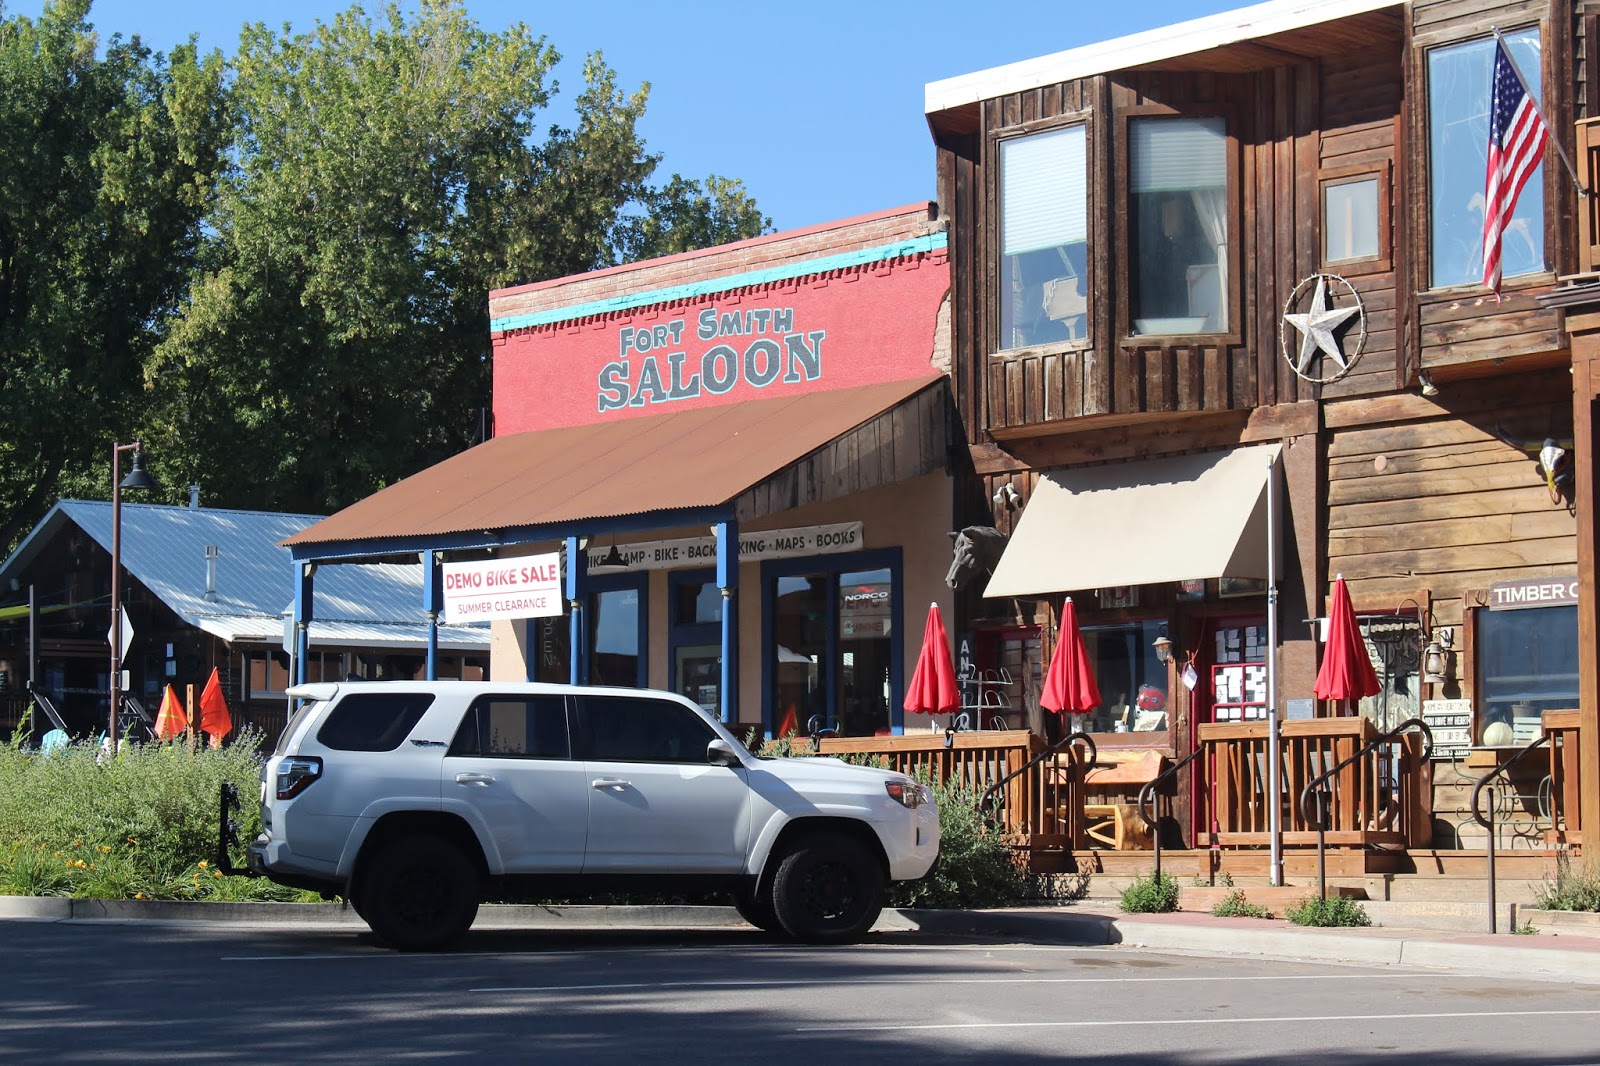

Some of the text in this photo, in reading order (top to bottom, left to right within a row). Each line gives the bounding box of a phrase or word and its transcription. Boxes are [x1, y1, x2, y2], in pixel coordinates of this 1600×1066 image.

[619, 307, 794, 357] FORT SMITH
[597, 330, 826, 413] SALOON
[588, 553, 607, 568] IKE
[654, 547, 679, 562] BIKE
[775, 536, 806, 551] MAPS
[816, 530, 856, 547] BOOKS
[446, 564, 557, 590] DEMO BIKE SALE
[458, 597, 547, 615] SUMMER CLEARANCE
[845, 591, 888, 601] NORCO
[1494, 583, 1566, 604] TIMBER
